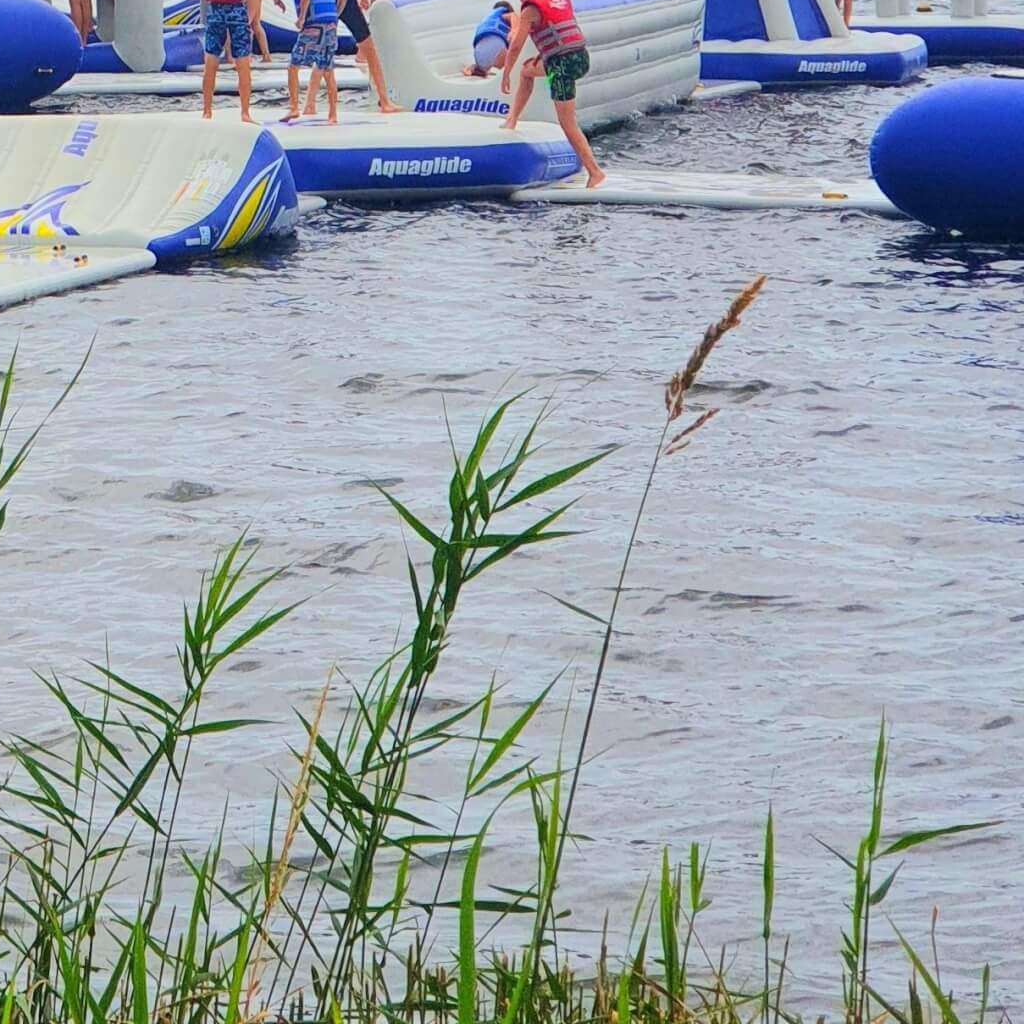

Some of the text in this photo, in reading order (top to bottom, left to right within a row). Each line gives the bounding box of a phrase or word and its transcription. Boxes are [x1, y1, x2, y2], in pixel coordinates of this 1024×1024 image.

[798, 59, 867, 74] Aquaglide
[414, 97, 510, 115] Aquaglide
[368, 156, 473, 178] Aquaglide
